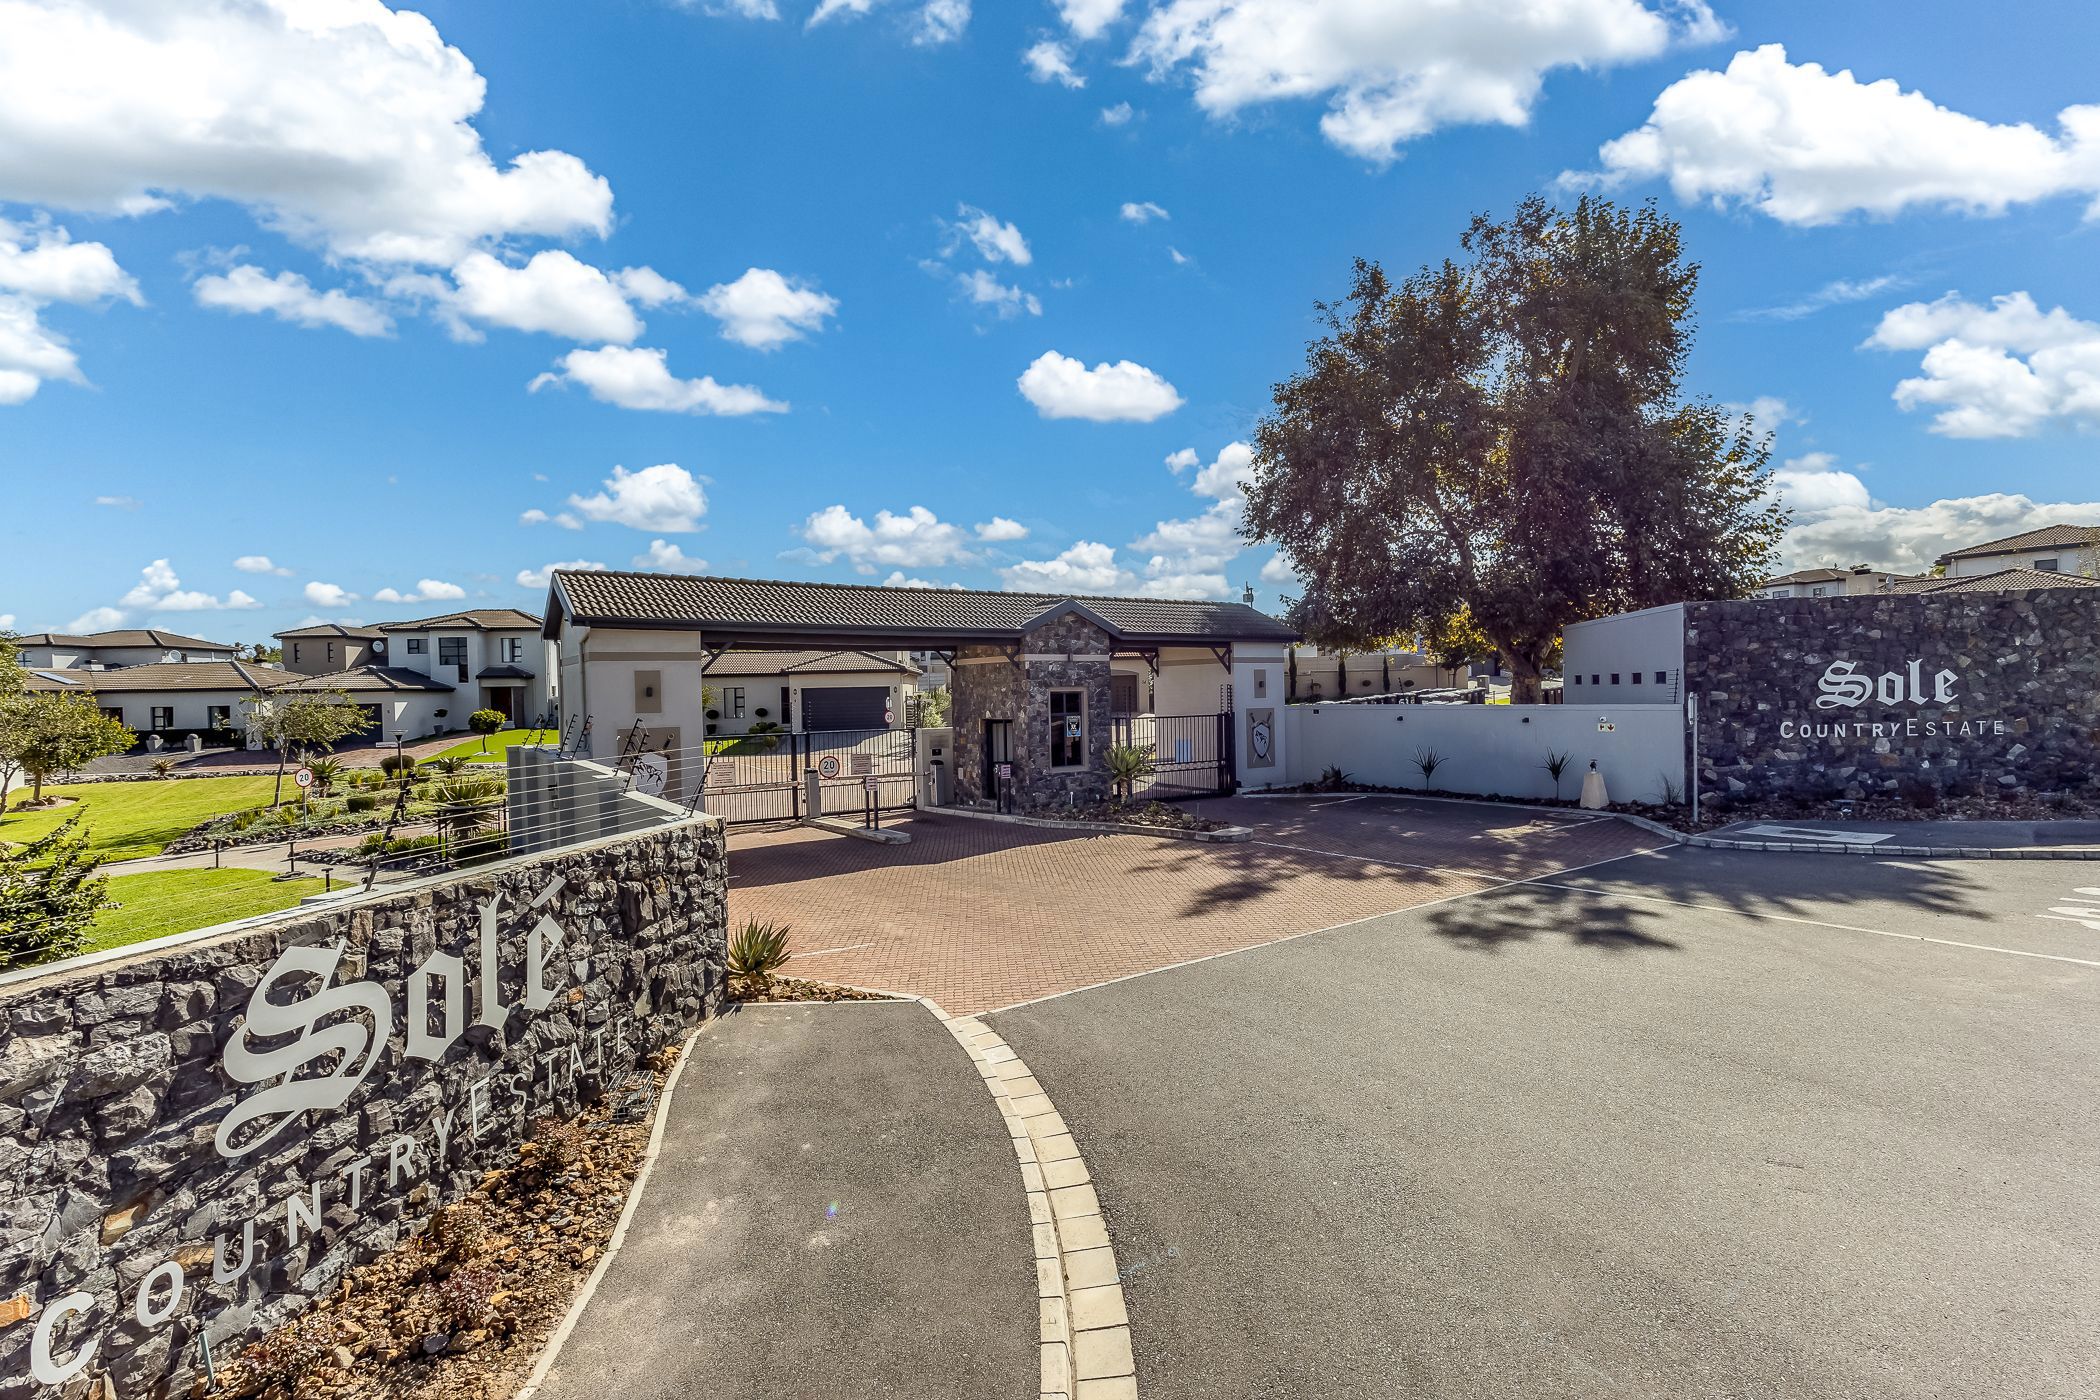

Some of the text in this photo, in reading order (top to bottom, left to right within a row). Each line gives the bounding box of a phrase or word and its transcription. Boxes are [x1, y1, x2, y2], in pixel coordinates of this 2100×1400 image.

[1815, 658, 1959, 709] Sole
[299, 773, 309, 782] 20
[823, 760, 835, 770] 20
[215, 876, 567, 1158] Solé
